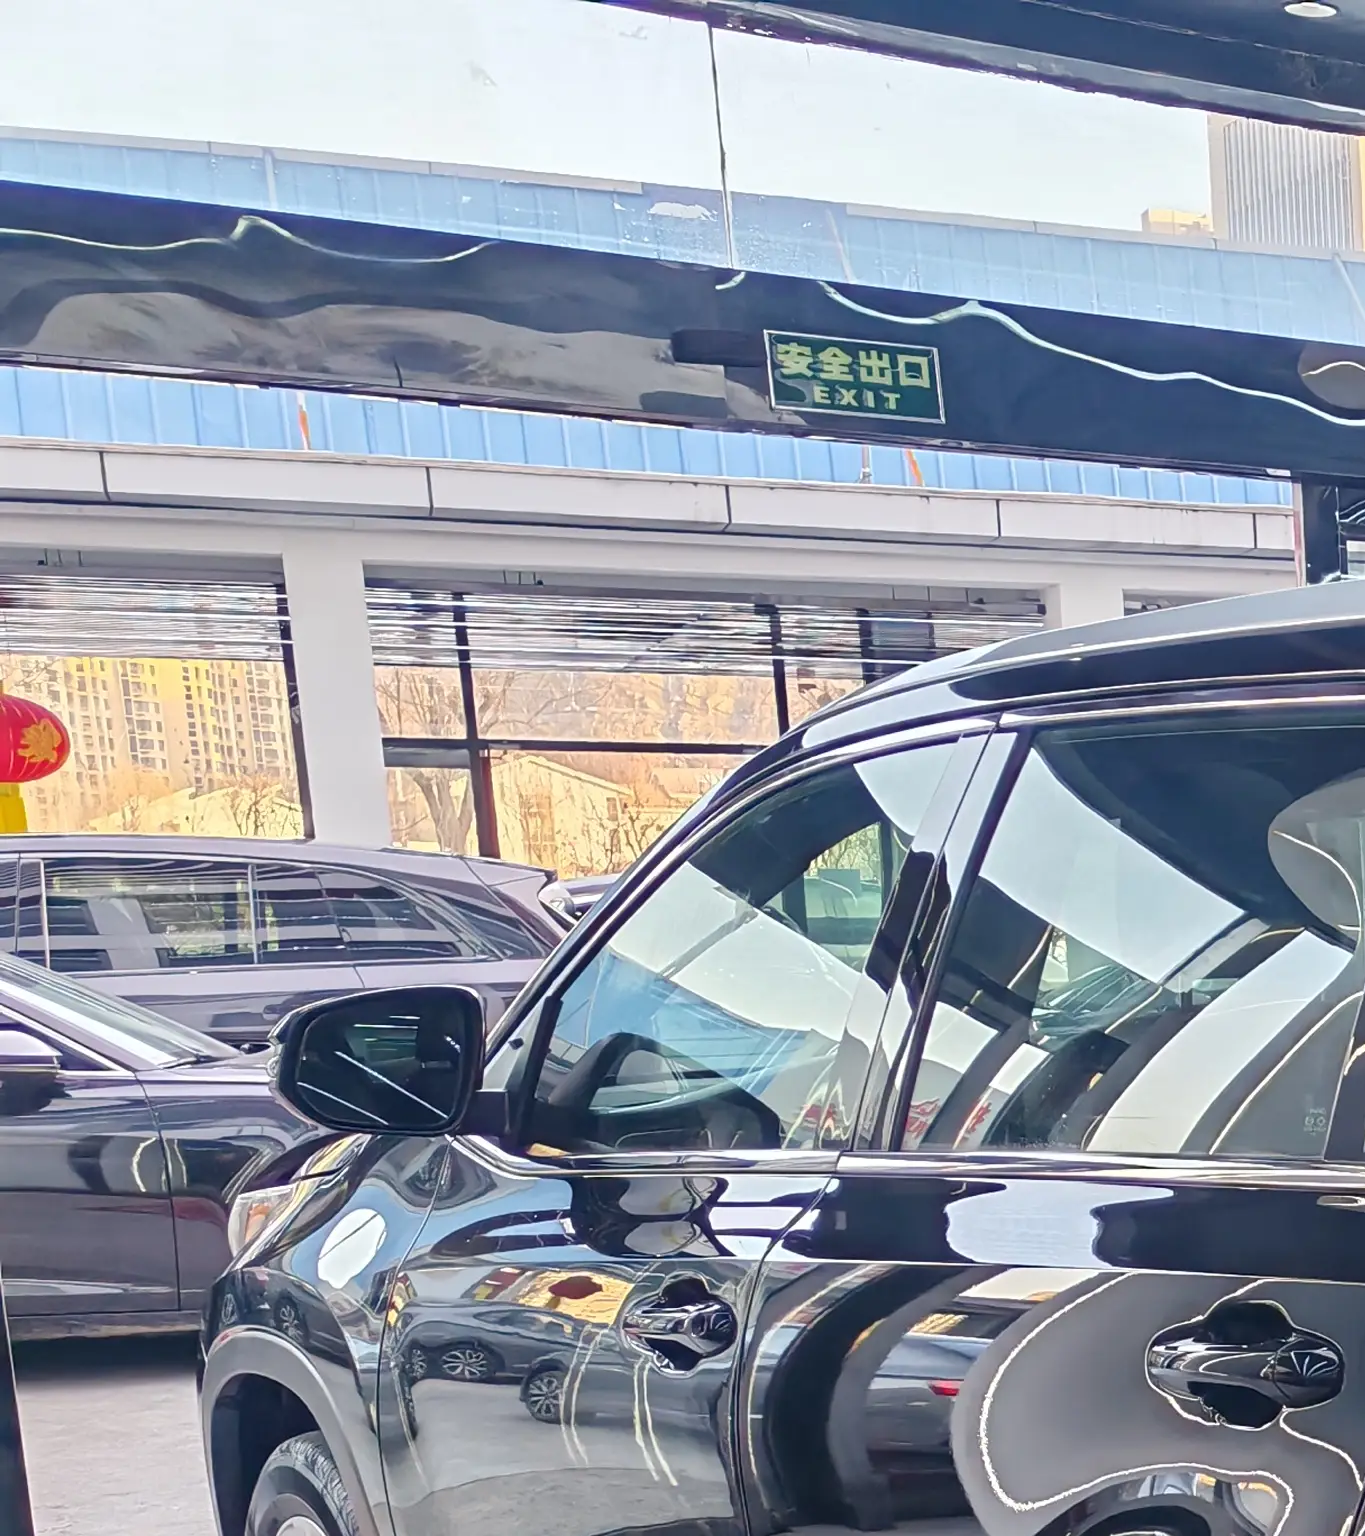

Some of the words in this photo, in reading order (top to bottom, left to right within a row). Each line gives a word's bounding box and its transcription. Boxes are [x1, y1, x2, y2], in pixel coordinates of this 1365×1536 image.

[777, 342, 931, 388] 安全出口
[813, 384, 901, 410] EXIT
